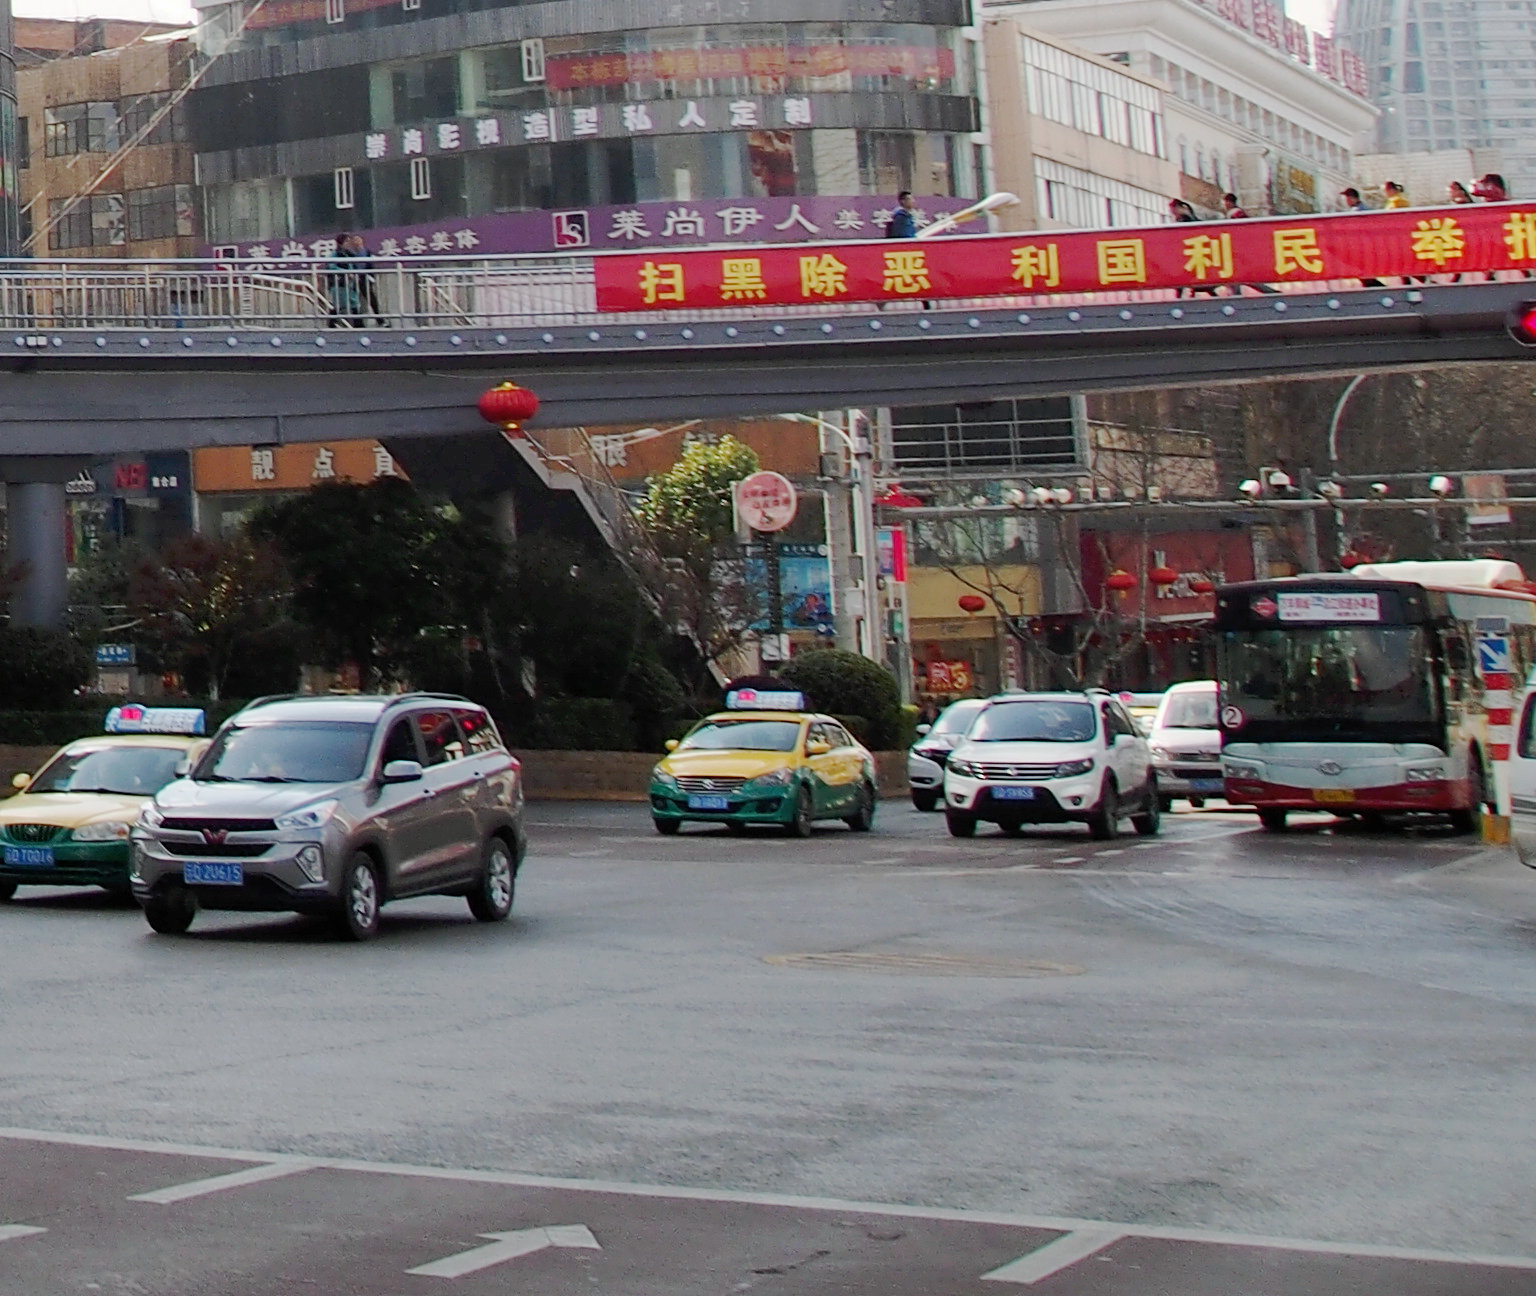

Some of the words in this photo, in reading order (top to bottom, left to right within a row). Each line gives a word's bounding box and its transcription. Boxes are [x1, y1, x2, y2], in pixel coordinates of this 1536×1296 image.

[606, 204, 821, 241] 莱尚伊人
[638, 250, 930, 305] 扫黑除恶
[1011, 227, 1324, 290] 利国利民
